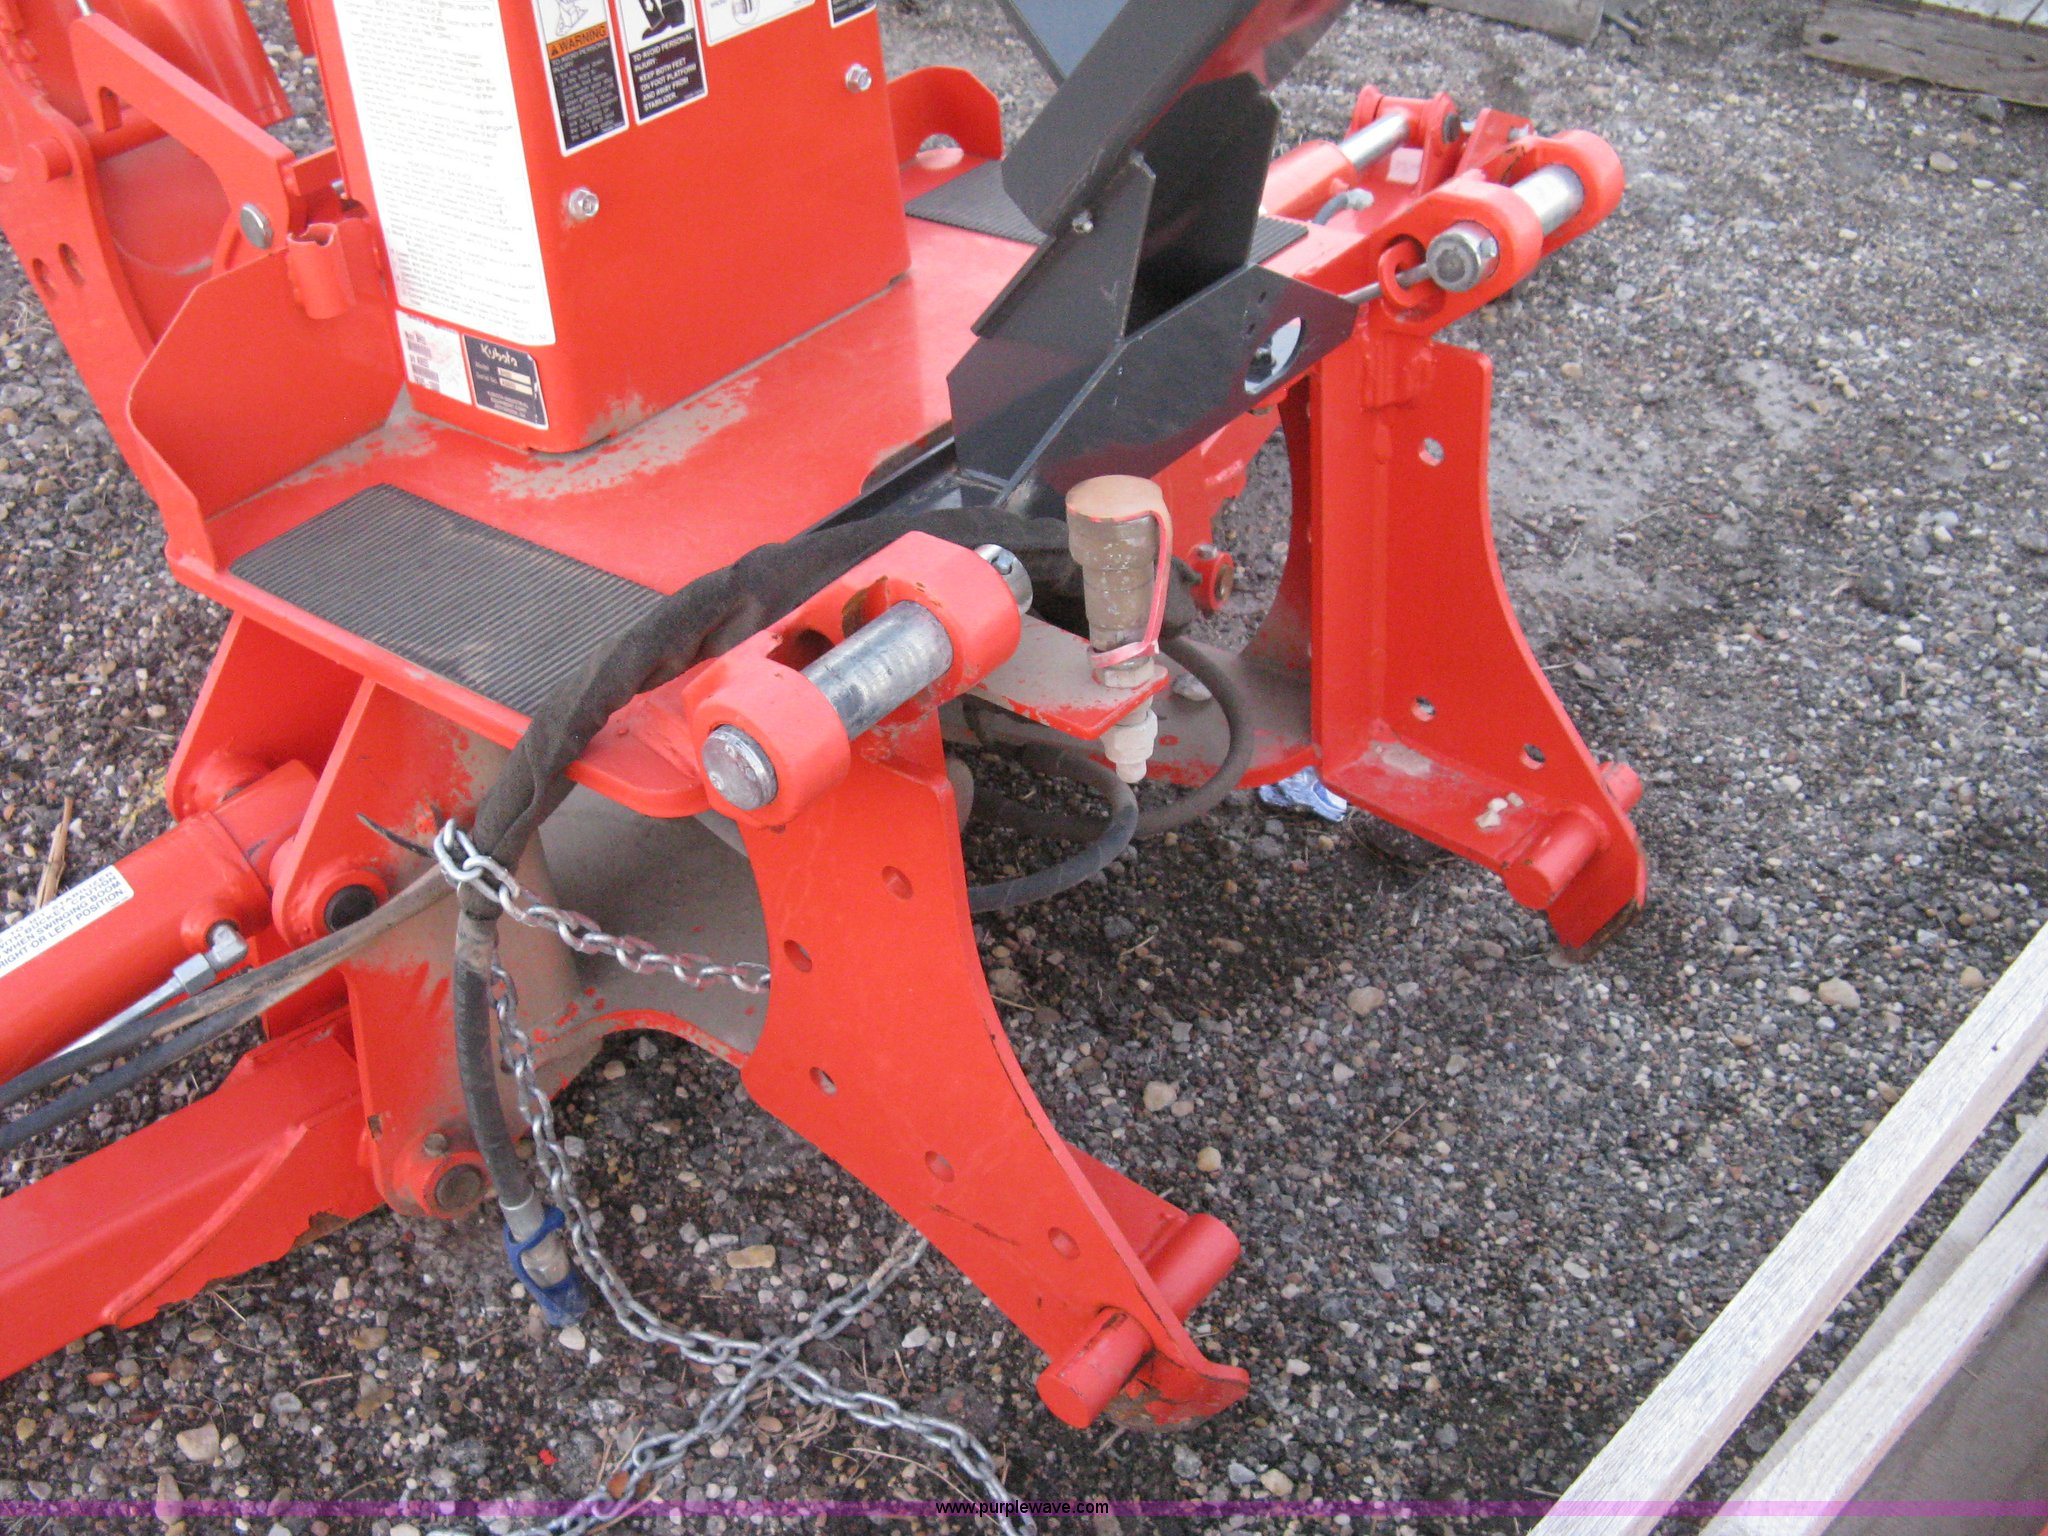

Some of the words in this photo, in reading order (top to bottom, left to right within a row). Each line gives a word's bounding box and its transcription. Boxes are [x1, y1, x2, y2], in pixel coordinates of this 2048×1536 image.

[559, 26, 607, 51] WARNING
[661, 33, 693, 52] PERSONAL
[639, 72, 655, 83] KEEP
[655, 64, 672, 76] BOTH
[672, 57, 686, 69] FEET
[651, 76, 666, 88] FOOT
[666, 63, 697, 82] PLATFORM
[642, 91, 656, 101] AND
[480, 343, 518, 367] Kubota
[4, 933, 35, 954] WHEN
[38, 902, 88, 935] SWINGING
[90, 881, 122, 901] BOOM
[24, 907, 66, 934] BUCKET
[71, 876, 117, 905] CAUTION
[0, 947, 29, 968] RIGHT
[31, 936, 48, 948] OR
[49, 920, 74, 937] LEFT
[76, 889, 124, 921] POSITION
